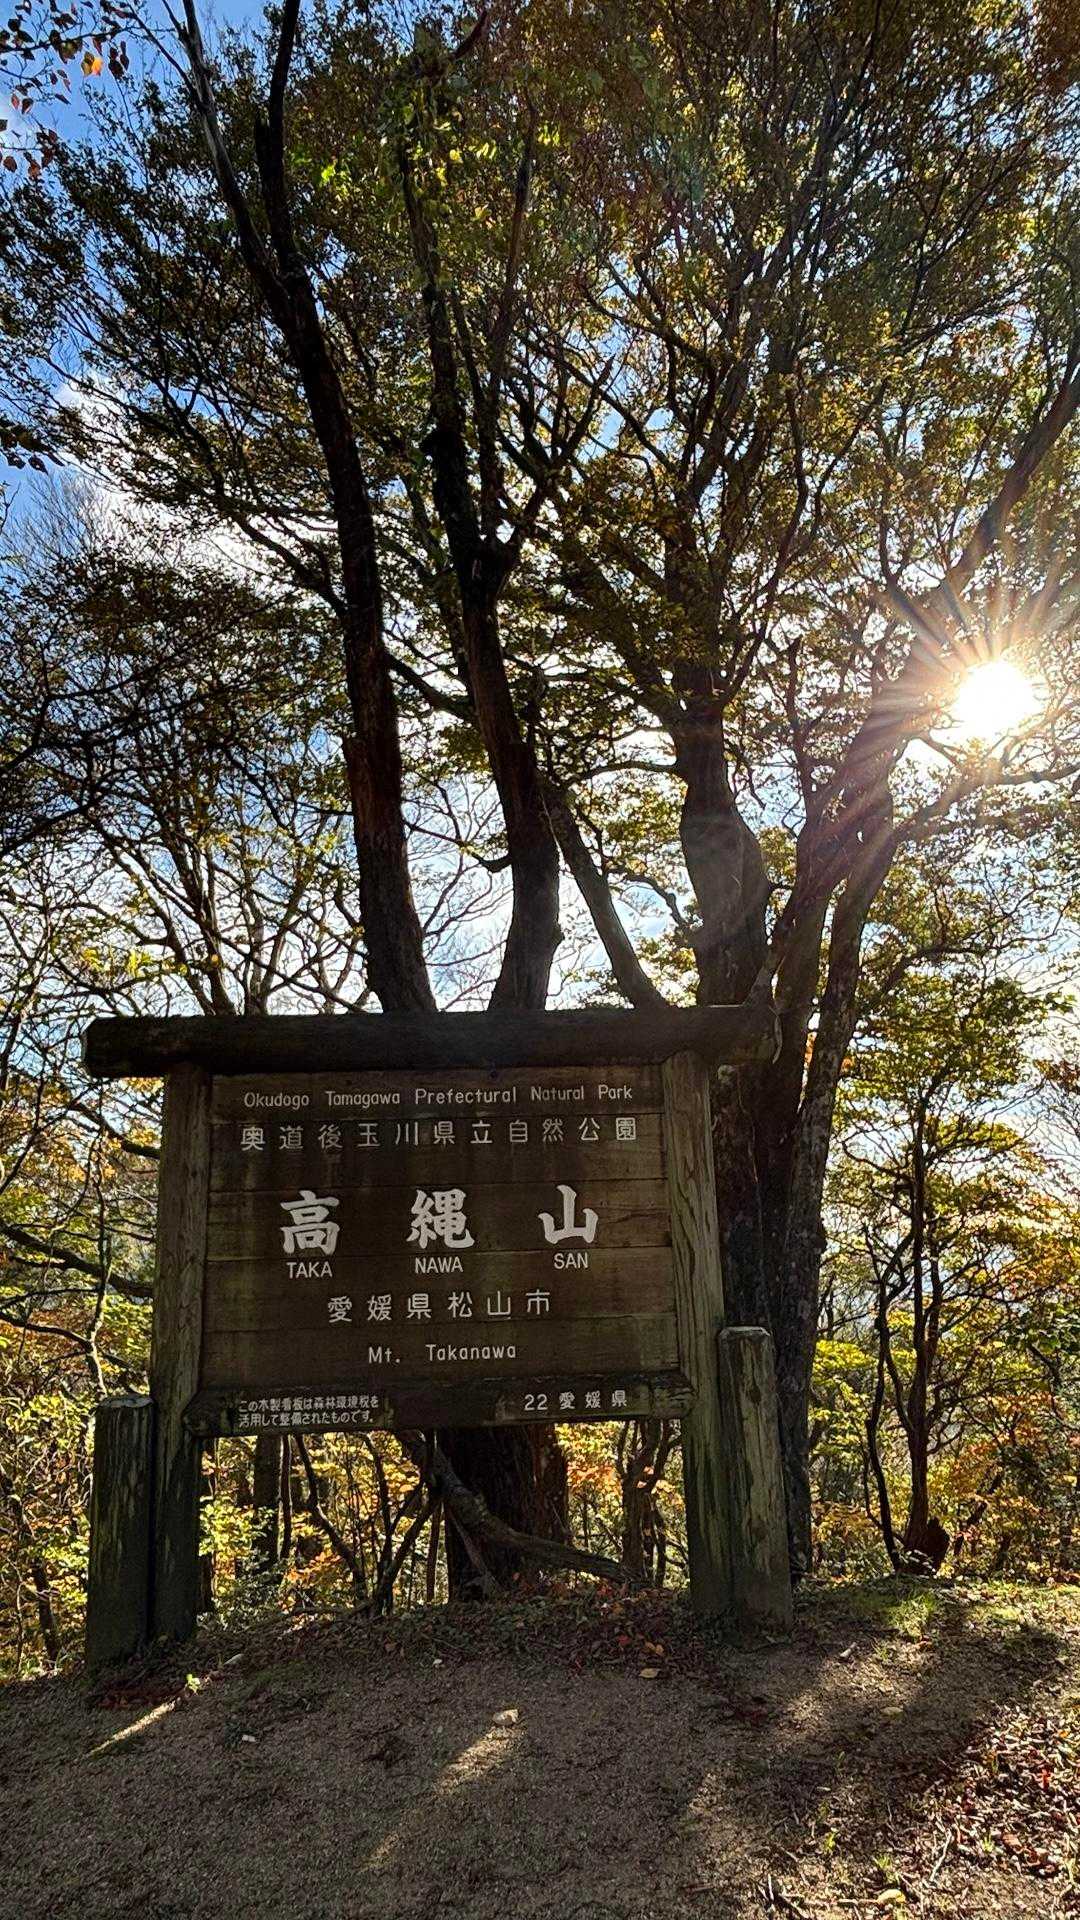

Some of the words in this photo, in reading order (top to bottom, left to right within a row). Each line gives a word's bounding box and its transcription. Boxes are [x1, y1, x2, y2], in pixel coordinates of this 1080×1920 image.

[243, 1092, 310, 1111] Okudogo
[325, 1090, 400, 1109] Tamagawa
[414, 1086, 517, 1105] Prefectural
[530, 1085, 584, 1101] Natural
[598, 1084, 633, 1100] Park
[240, 1117, 636, 1151] 奥道後玉川県立自然公園
[286, 1261, 333, 1279] TAKA
[414, 1256, 464, 1274] NAWA
[553, 1252, 589, 1270] SAN
[327, 1289, 551, 1323] 愛媛県松山市
[368, 1346, 401, 1364] Mt.
[425, 1343, 517, 1362] Takanawa
[524, 1393, 549, 1411] 22
[559, 1389, 628, 1410] 愛媛県
